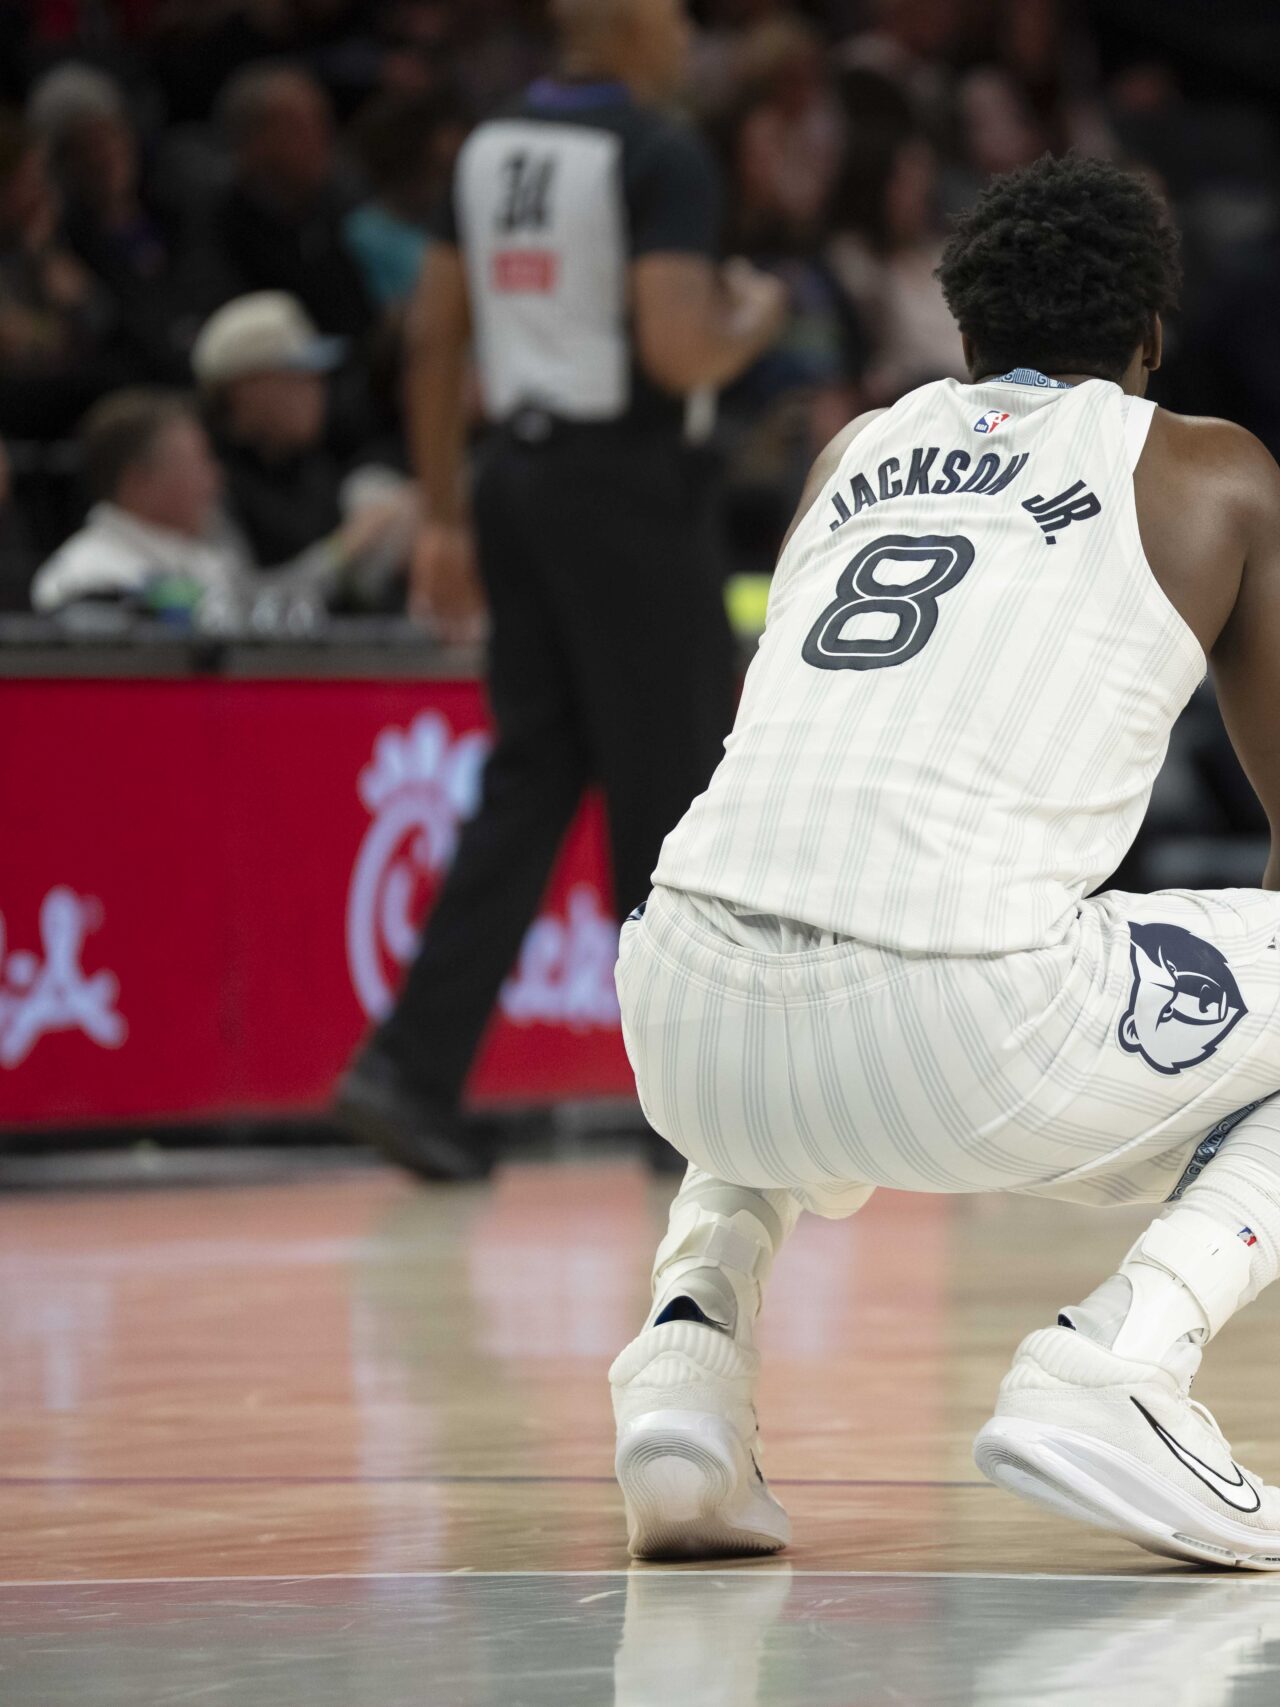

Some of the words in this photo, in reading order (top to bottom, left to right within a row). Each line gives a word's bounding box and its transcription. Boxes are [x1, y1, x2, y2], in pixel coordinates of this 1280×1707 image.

[828, 447, 1030, 532] JACKSON
[1021, 479, 1102, 545] JR.
[801, 534, 976, 671] 8
